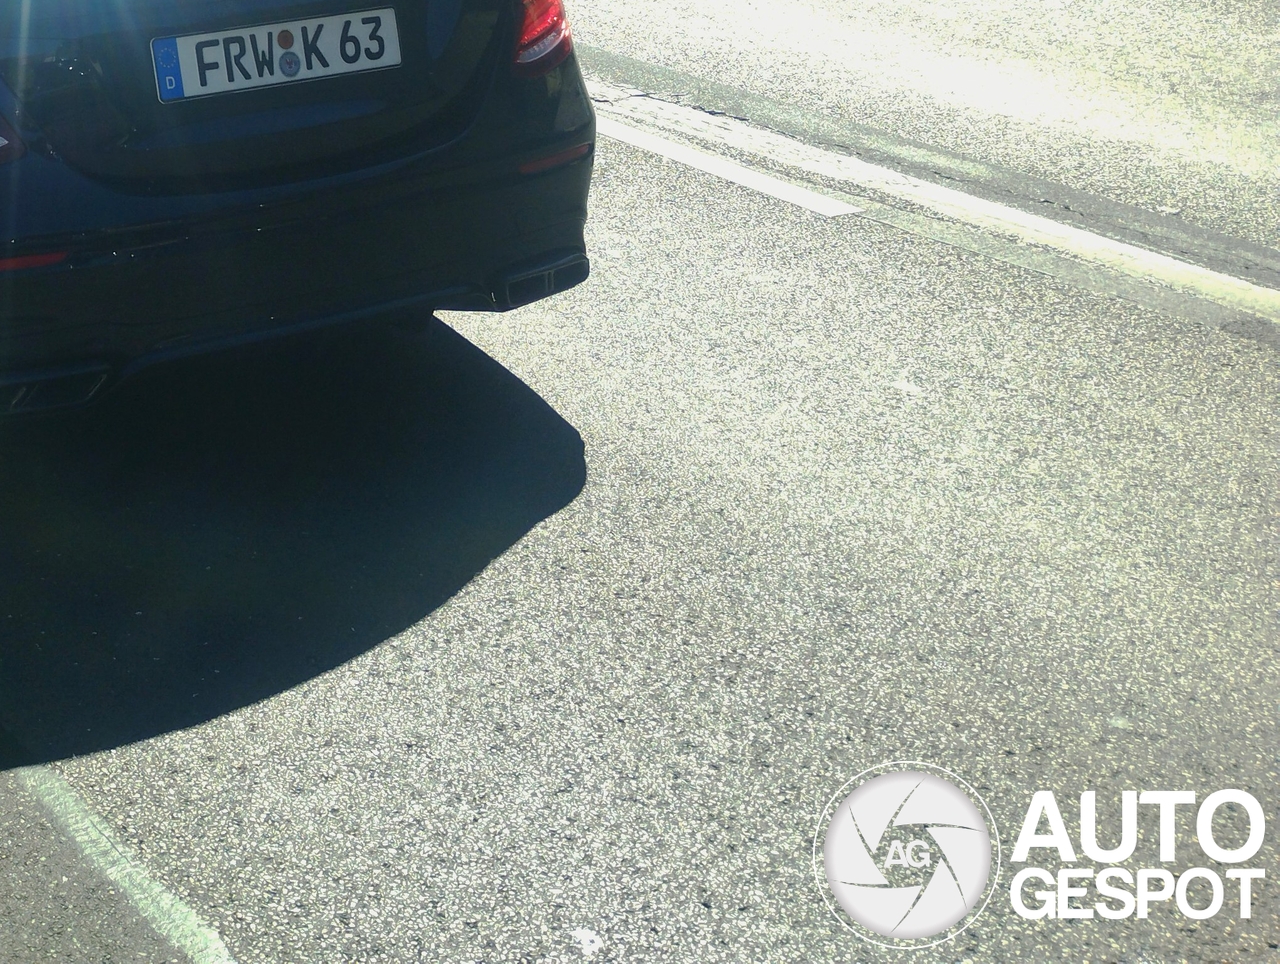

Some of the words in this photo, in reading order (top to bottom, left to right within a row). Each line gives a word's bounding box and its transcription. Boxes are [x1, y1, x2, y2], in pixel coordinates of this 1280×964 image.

[195, 32, 274, 87] FRW
[301, 24, 330, 70] K
[339, 15, 385, 64] 63
